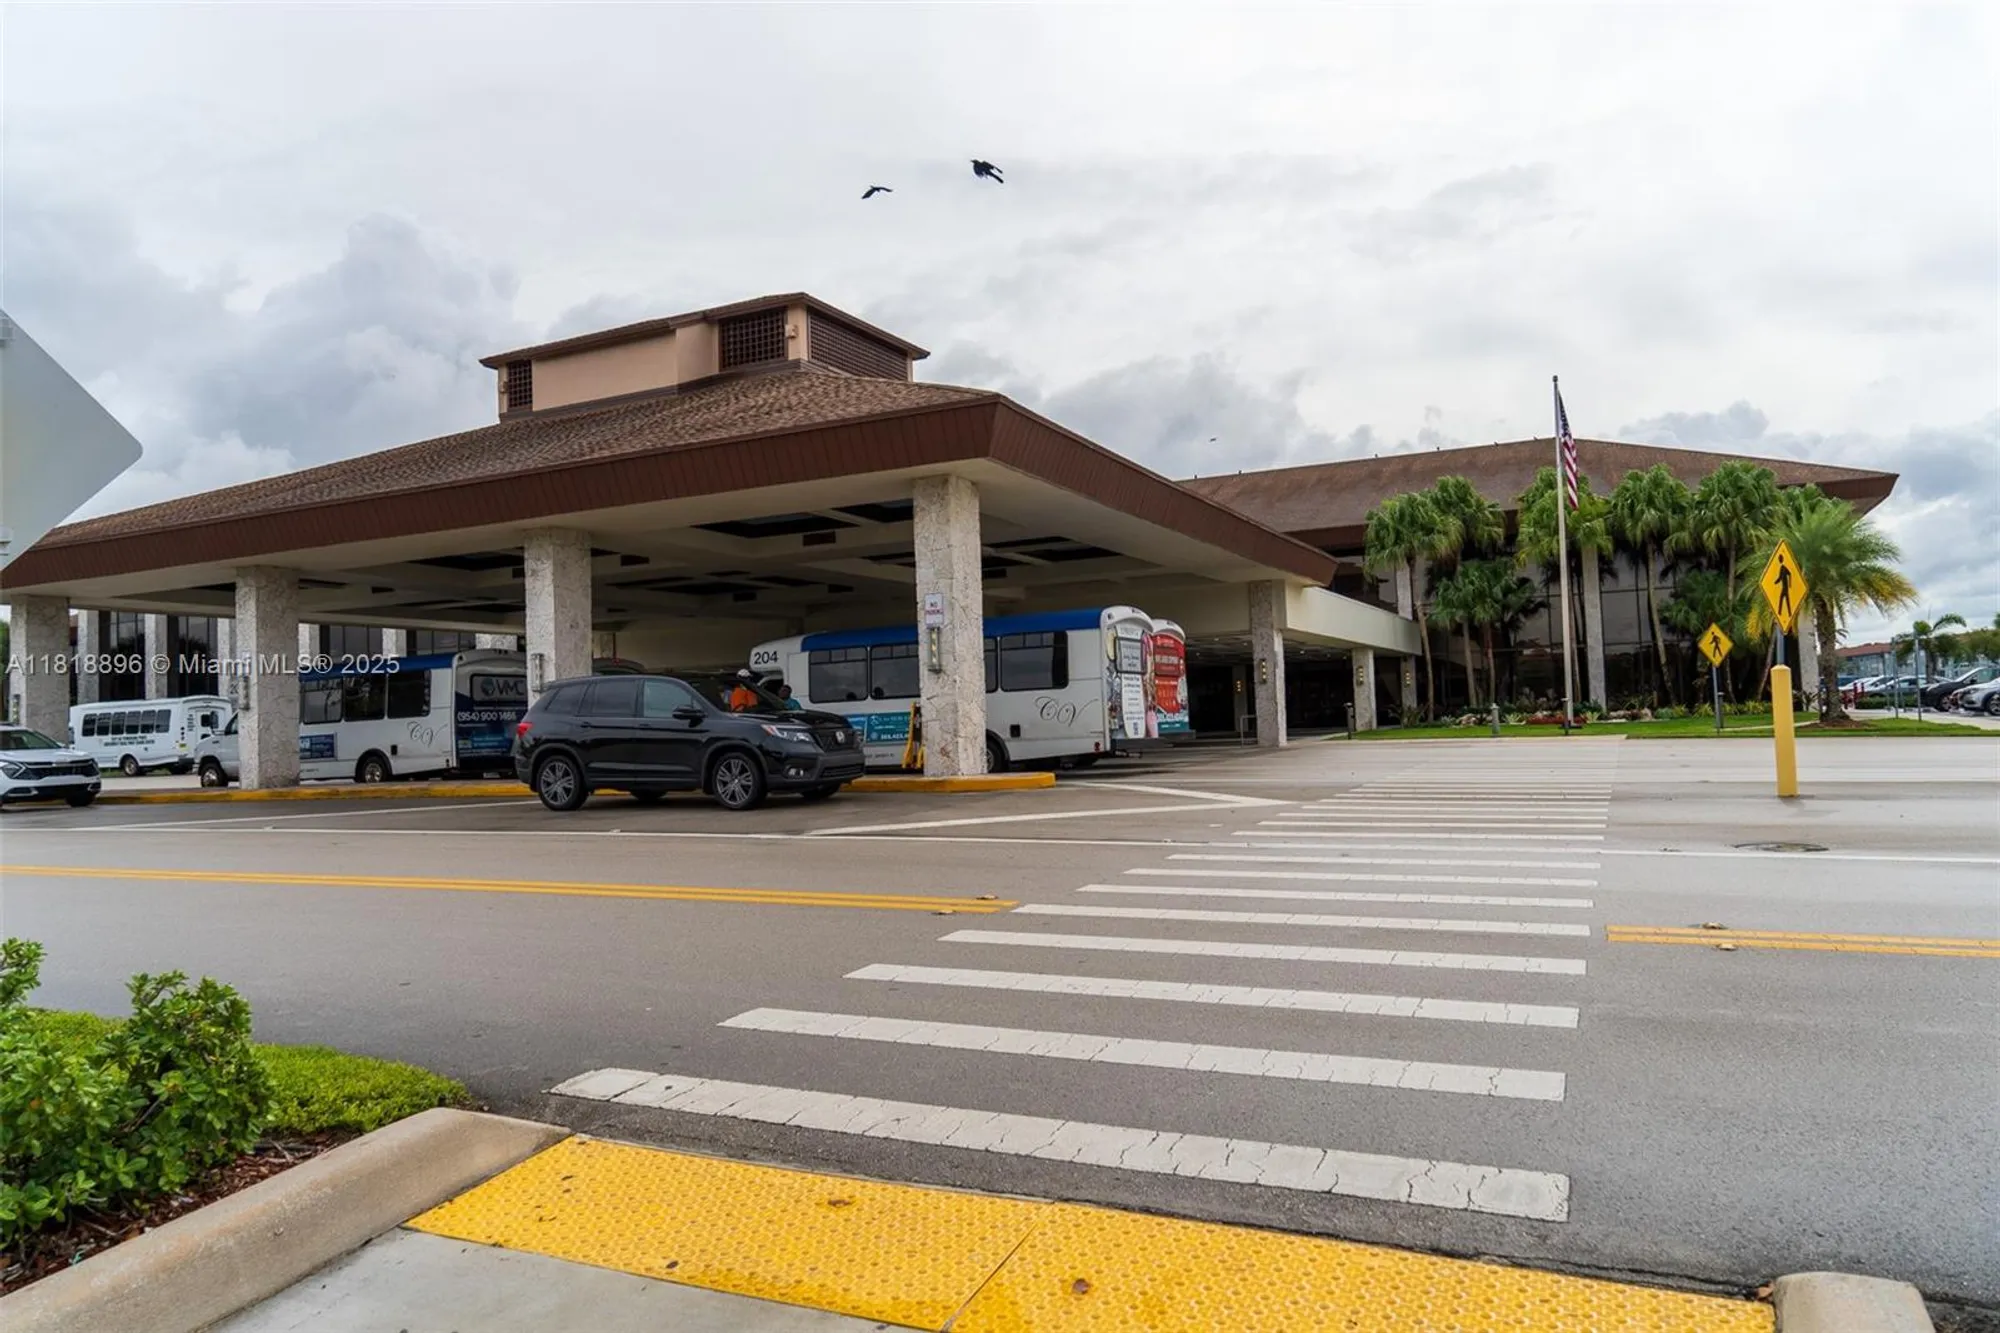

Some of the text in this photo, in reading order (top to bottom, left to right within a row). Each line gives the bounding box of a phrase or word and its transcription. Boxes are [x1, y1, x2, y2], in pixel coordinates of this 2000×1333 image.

[754, 650, 779, 665] 204
[457, 711, 480, 722] (954)
[480, 711, 498, 721] 900
